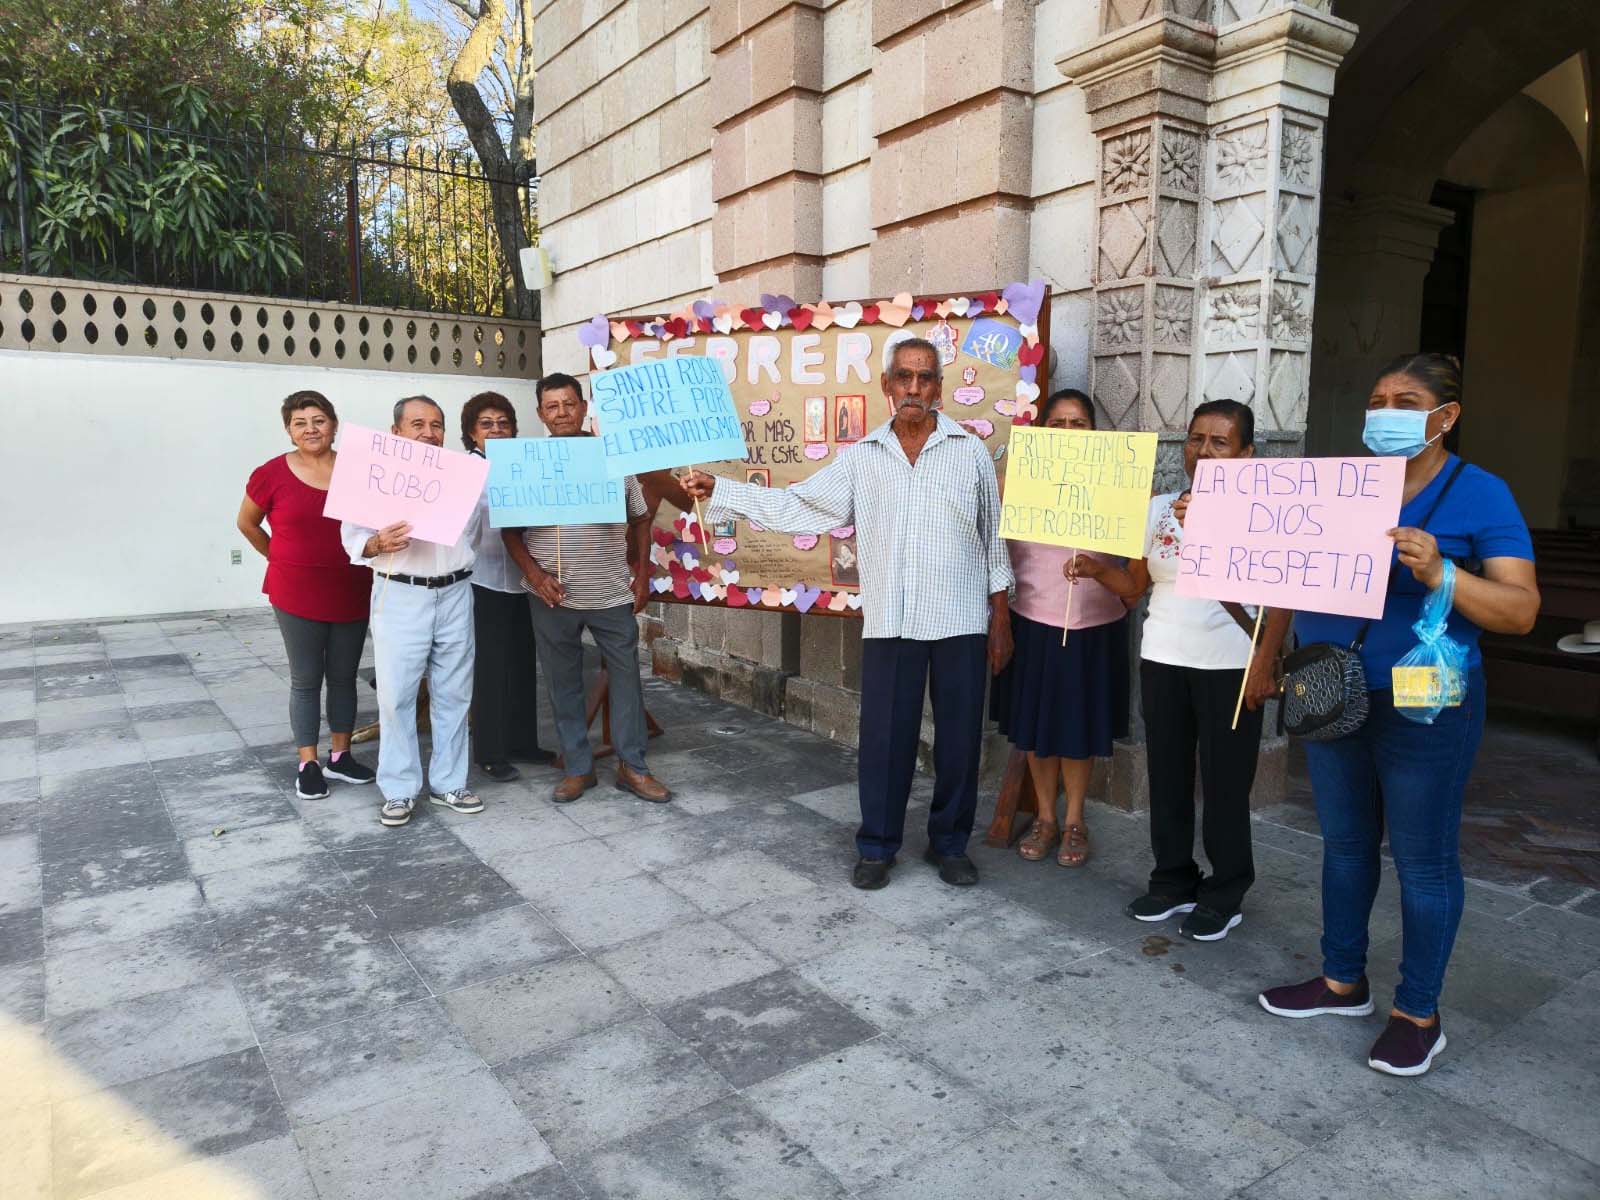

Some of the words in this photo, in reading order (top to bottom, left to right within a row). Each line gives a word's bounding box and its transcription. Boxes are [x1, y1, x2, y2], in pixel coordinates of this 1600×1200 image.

[978, 332, 1009, 353] 40
[596, 362, 671, 400] SANTA
[676, 358, 723, 385] ROSA
[601, 389, 688, 424] SUFRE
[691, 387, 730, 413] POR
[371, 432, 412, 461] ALTO
[421, 447, 444, 470] AL
[524, 440, 570, 461] ALTO
[603, 432, 631, 457] EL
[630, 416, 740, 452] BANDALISMO
[1012, 431, 1137, 465] PROTESTAMOS
[368, 463, 441, 503] ROBO
[511, 462, 522, 480] A
[541, 461, 566, 481] LA
[1018, 456, 1055, 481] POR
[1062, 460, 1108, 487] ESTE
[1196, 464, 1226, 494] LA
[1236, 461, 1318, 497] CASA
[1337, 462, 1381, 498] DE
[488, 481, 619, 508] DELINCUENCIA
[1052, 483, 1097, 511] TAN
[1002, 504, 1129, 540] REPROBABLE
[1248, 502, 1329, 536] DIOS
[1180, 544, 1212, 577] SE
[1226, 546, 1374, 594] RESPETA
